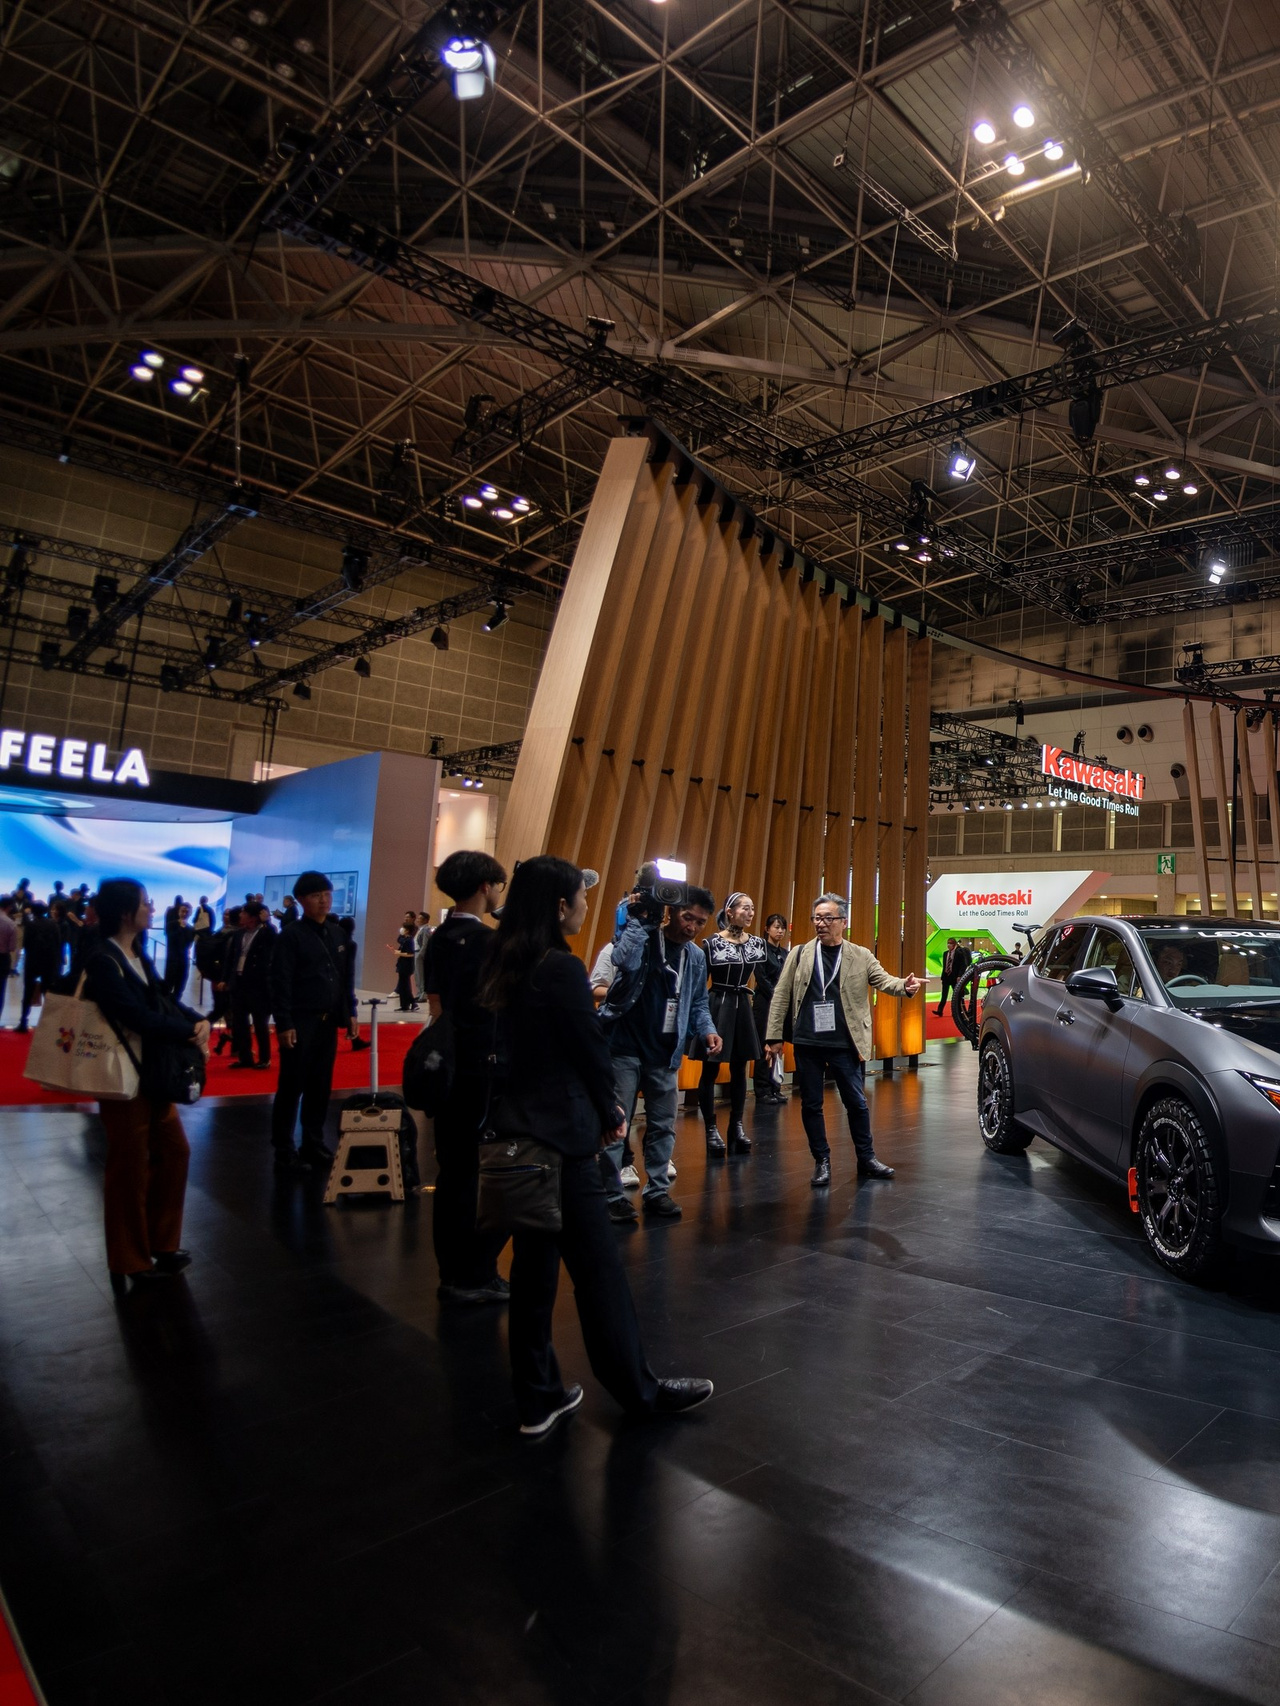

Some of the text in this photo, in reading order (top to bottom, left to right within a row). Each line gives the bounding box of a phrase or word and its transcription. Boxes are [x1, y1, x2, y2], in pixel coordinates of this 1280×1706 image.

[1042, 744, 1144, 800] Kawasaki
[1048, 784, 1139, 816] Let the Good Times Roll
[956, 889, 1032, 906] Kawasaki
